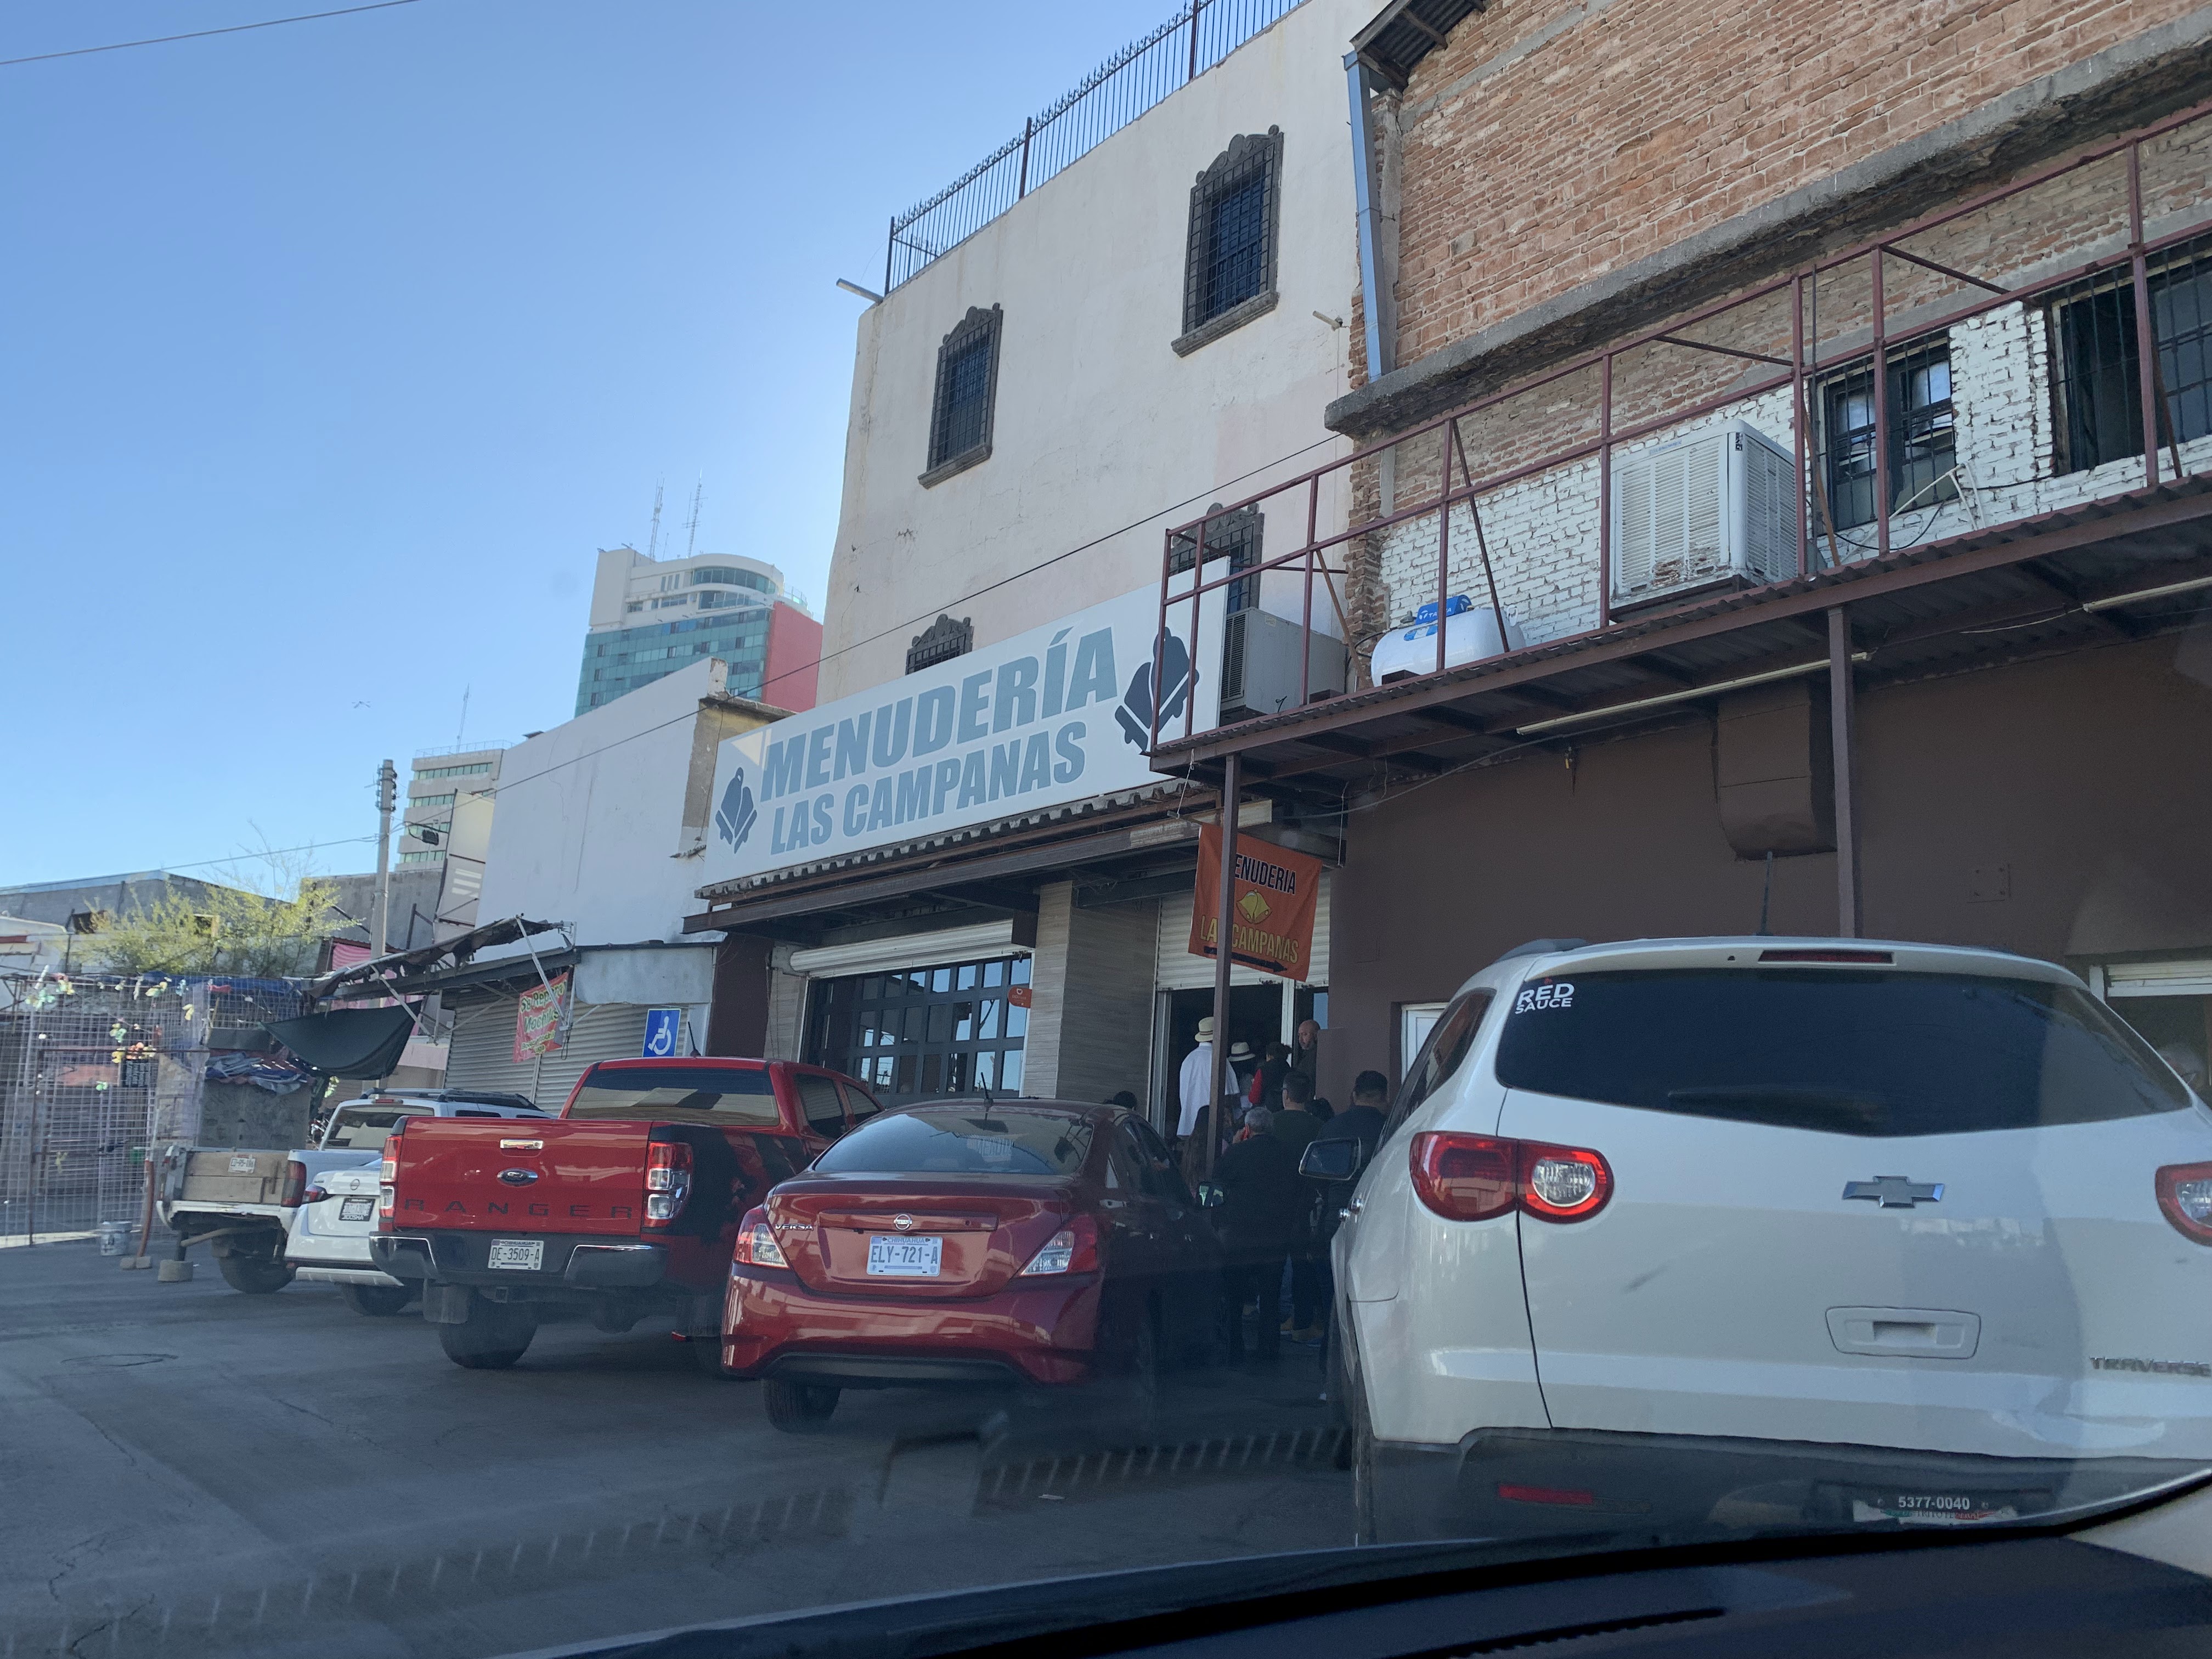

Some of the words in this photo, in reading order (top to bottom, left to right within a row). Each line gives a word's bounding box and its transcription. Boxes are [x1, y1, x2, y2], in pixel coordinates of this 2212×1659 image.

[1429, 607, 1452, 618] TAA
[761, 625, 1118, 803] MENUDERÍA
[770, 798, 833, 855] LAS
[843, 721, 1087, 837] CAMPANAS
[1235, 853, 1295, 895] ENUDERIA
[1200, 915, 1217, 943] LA
[1232, 923, 1299, 964] CAMPANAS
[1517, 983, 1575, 1006] RED
[1515, 997, 1573, 1014] SAUCE
[404, 1199, 632, 1220] RANGER
[491, 1247, 539, 1262] DE-3509-A
[871, 1245, 938, 1264] ELY-721-A
[1898, 1496, 1970, 1509] 5377-0040
